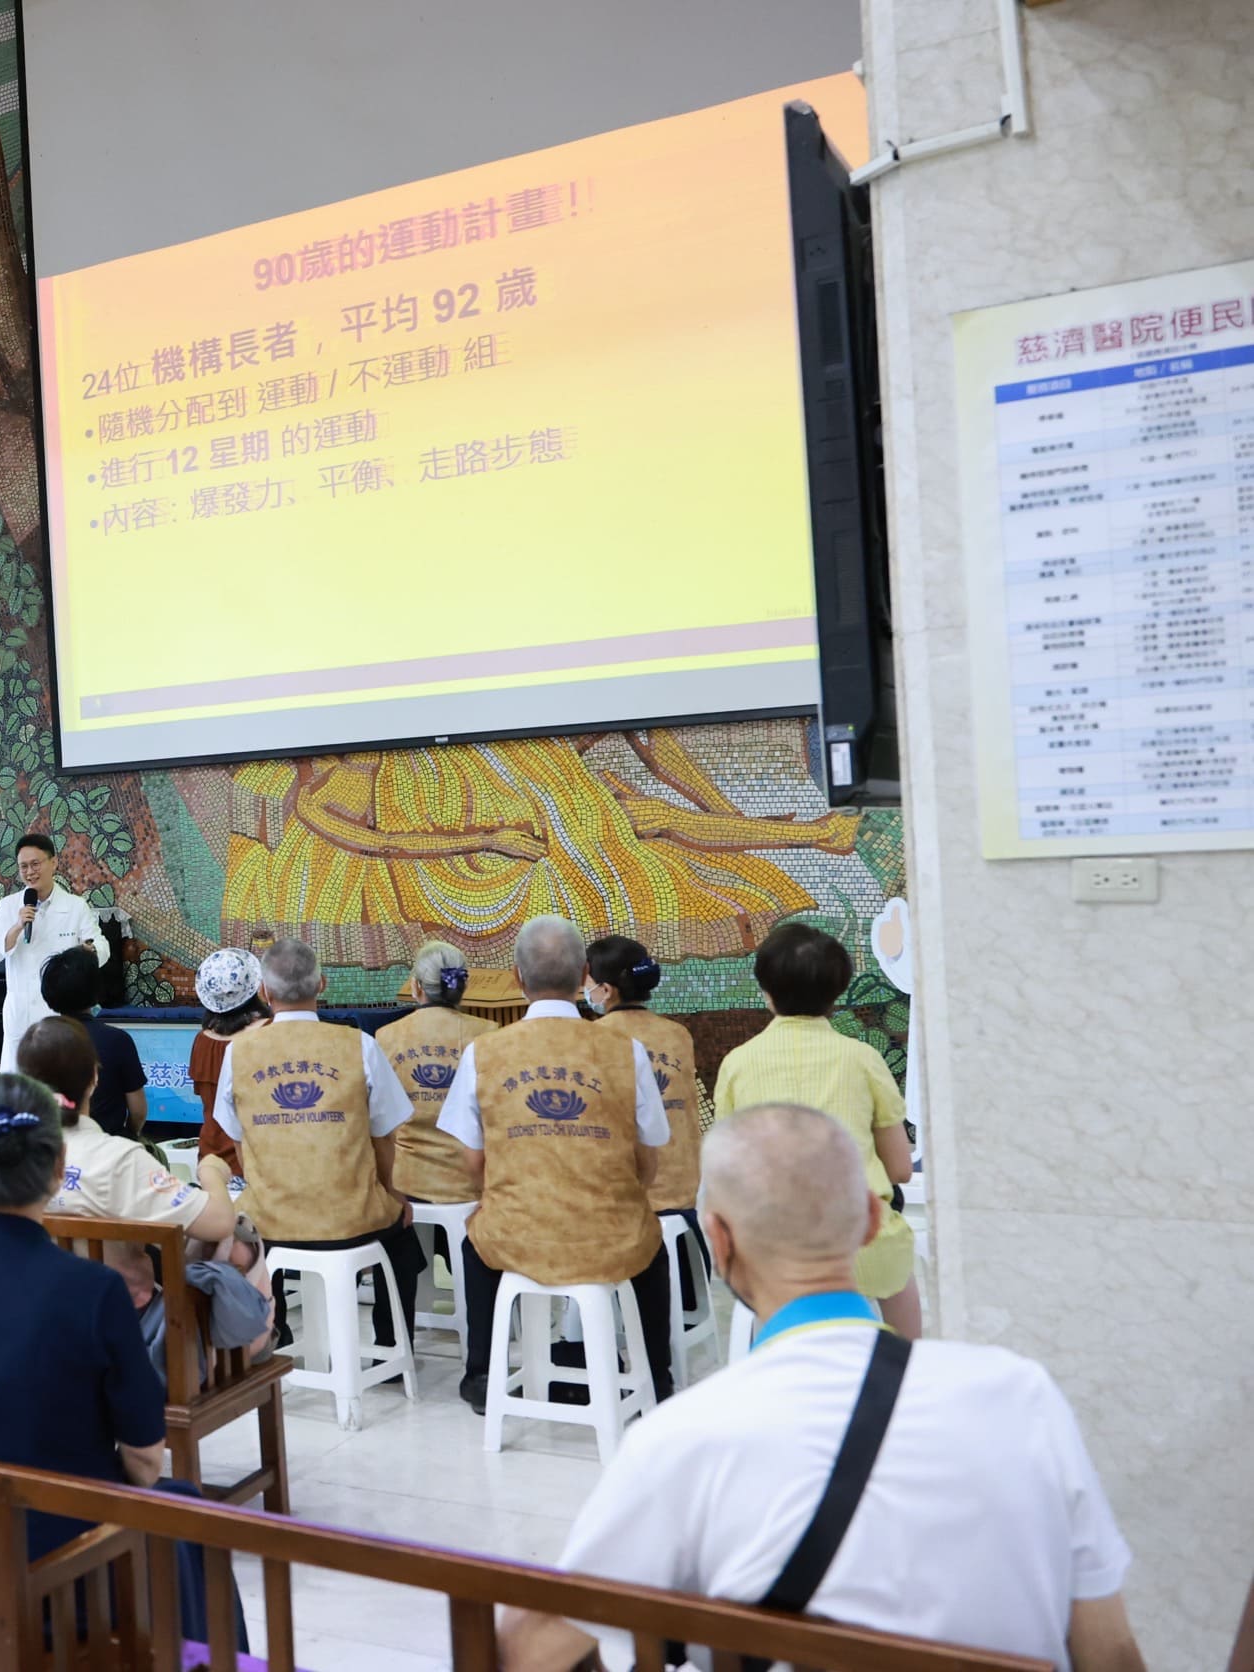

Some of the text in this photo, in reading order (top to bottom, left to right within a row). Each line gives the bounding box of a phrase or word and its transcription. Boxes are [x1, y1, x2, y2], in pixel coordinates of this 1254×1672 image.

[433, 283, 481, 324] 92
[496, 266, 539, 313] 歲
[1017, 296, 1254, 366] 慈濟醫院便民
[98, 386, 248, 446] 隨機分配到
[257, 371, 320, 414] 運動
[348, 344, 450, 392] 不運動
[463, 334, 497, 372] 組
[209, 429, 271, 471] 星期
[281, 408, 379, 457] 的運動
[252, 1060, 339, 1084] 佛教慈濟志工
